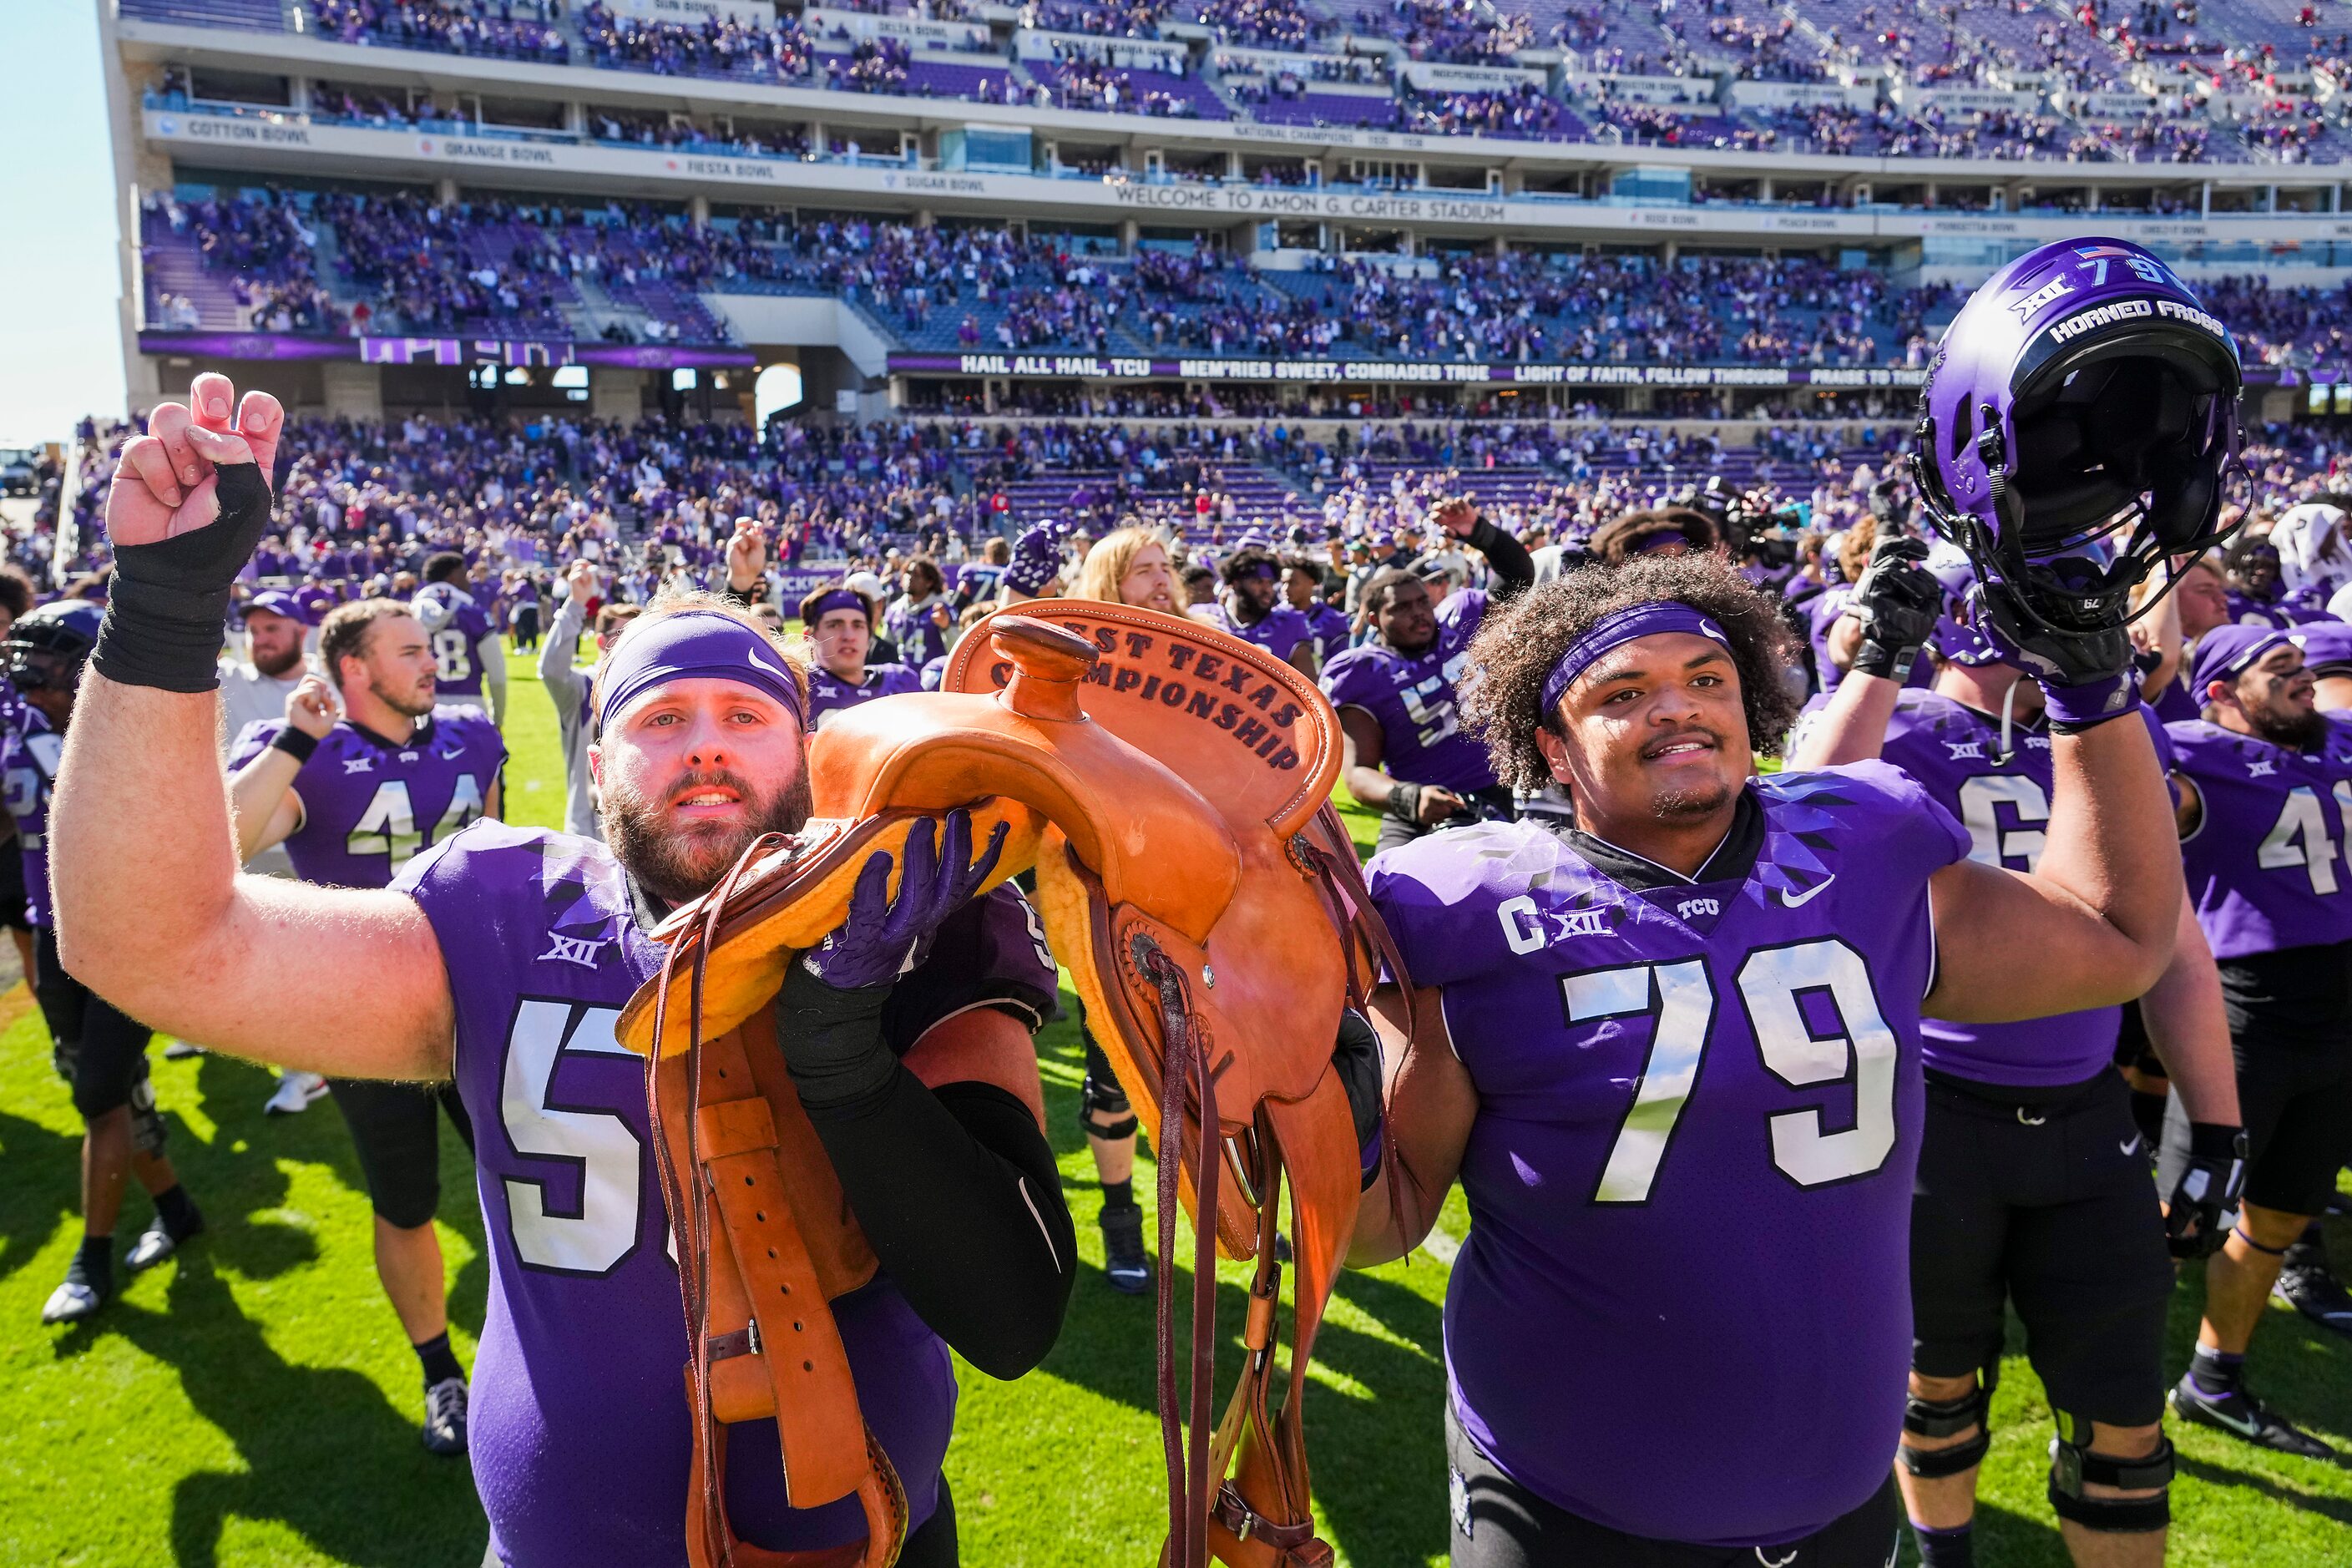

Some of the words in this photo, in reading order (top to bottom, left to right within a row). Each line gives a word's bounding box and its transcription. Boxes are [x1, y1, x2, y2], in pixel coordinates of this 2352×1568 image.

[189, 119, 256, 140] COTTON
[260, 128, 310, 144] BOWL
[444, 141, 505, 159] ORANGE
[510, 147, 554, 163] BOWL
[686, 159, 731, 176] FIESTA
[736, 164, 775, 179] BOWL
[905, 175, 947, 190] SUGAR
[950, 180, 986, 193] BOWL
[1116, 185, 1216, 208] WELCOME
[1227, 192, 1251, 209] TO
[1260, 193, 1318, 212] AMON
[1327, 195, 1342, 212] G.
[1350, 197, 1419, 216] CARTER
[1429, 201, 1505, 220] STADIUM
[2076, 253, 2178, 288] 79
[2049, 299, 2152, 344] HORNED
[2155, 300, 2224, 337] FROGS
[961, 355, 1010, 374] HAIL
[1013, 356, 1052, 375] ALL
[1055, 357, 1108, 377] HAIL,
[1110, 358, 1151, 377] TCU
[1275, 361, 1341, 382] SWEET,
[1344, 362, 1442, 382] COMRADES
[1444, 364, 1490, 382] TRUE
[1514, 366, 1565, 382] LIGHT
[1566, 367, 1588, 382] OF
[1591, 367, 1644, 385] FAITH,
[1646, 367, 1712, 383] FOLLOW
[1713, 367, 1788, 384] THROUGH
[1810, 369, 1868, 385] PRAISE
[1869, 369, 1890, 385] TO
[1063, 621, 1153, 659] ST
[1169, 643, 1304, 729] TEXAS
[990, 662, 1300, 770] CMPIONSHIP
[346, 773, 483, 878] 44
[2257, 778, 2352, 896] 4
[1497, 894, 1545, 956] C
[1677, 898, 1720, 920] TCU
[1558, 935, 1900, 1206] 79
[499, 995, 680, 1277] 5
